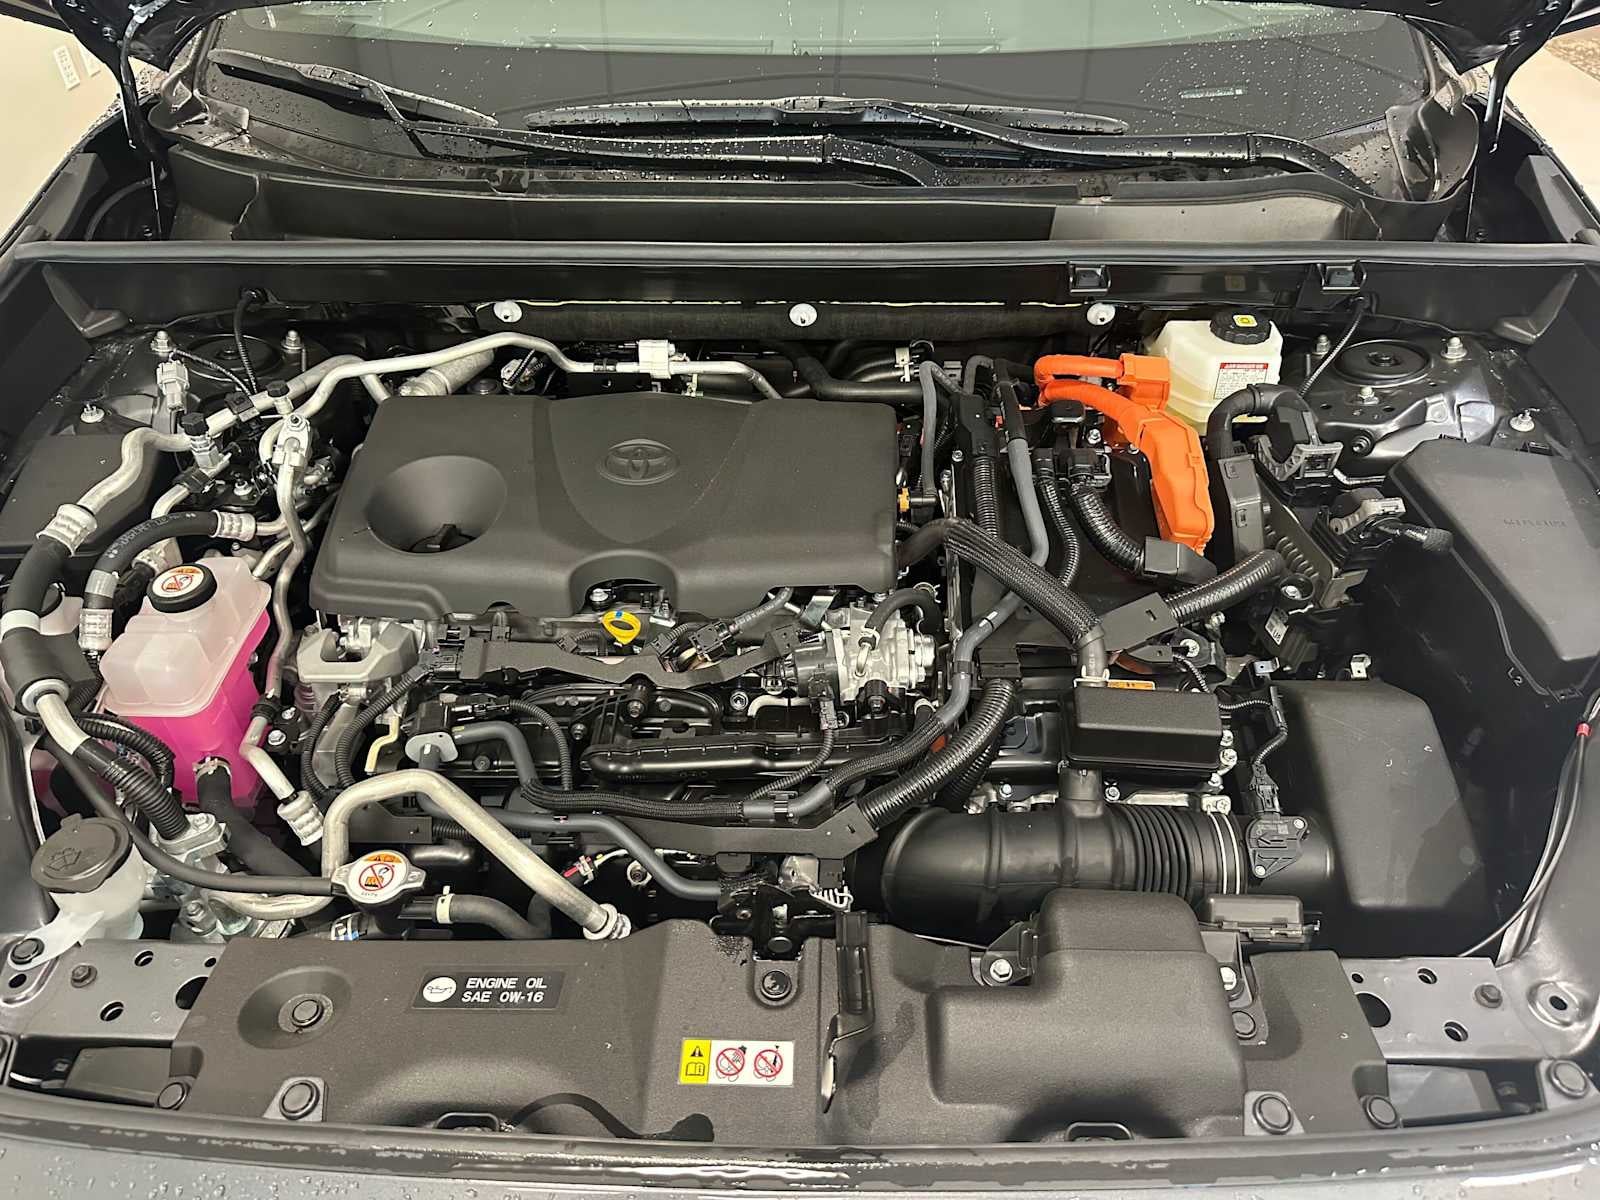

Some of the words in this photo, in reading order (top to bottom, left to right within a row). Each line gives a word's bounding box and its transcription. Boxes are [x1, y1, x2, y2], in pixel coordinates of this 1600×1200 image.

[465, 977, 518, 989] ENGINE
[525, 977, 548, 989] OIL
[461, 991, 492, 1003] SAE
[499, 991, 545, 1003] 0W-16
